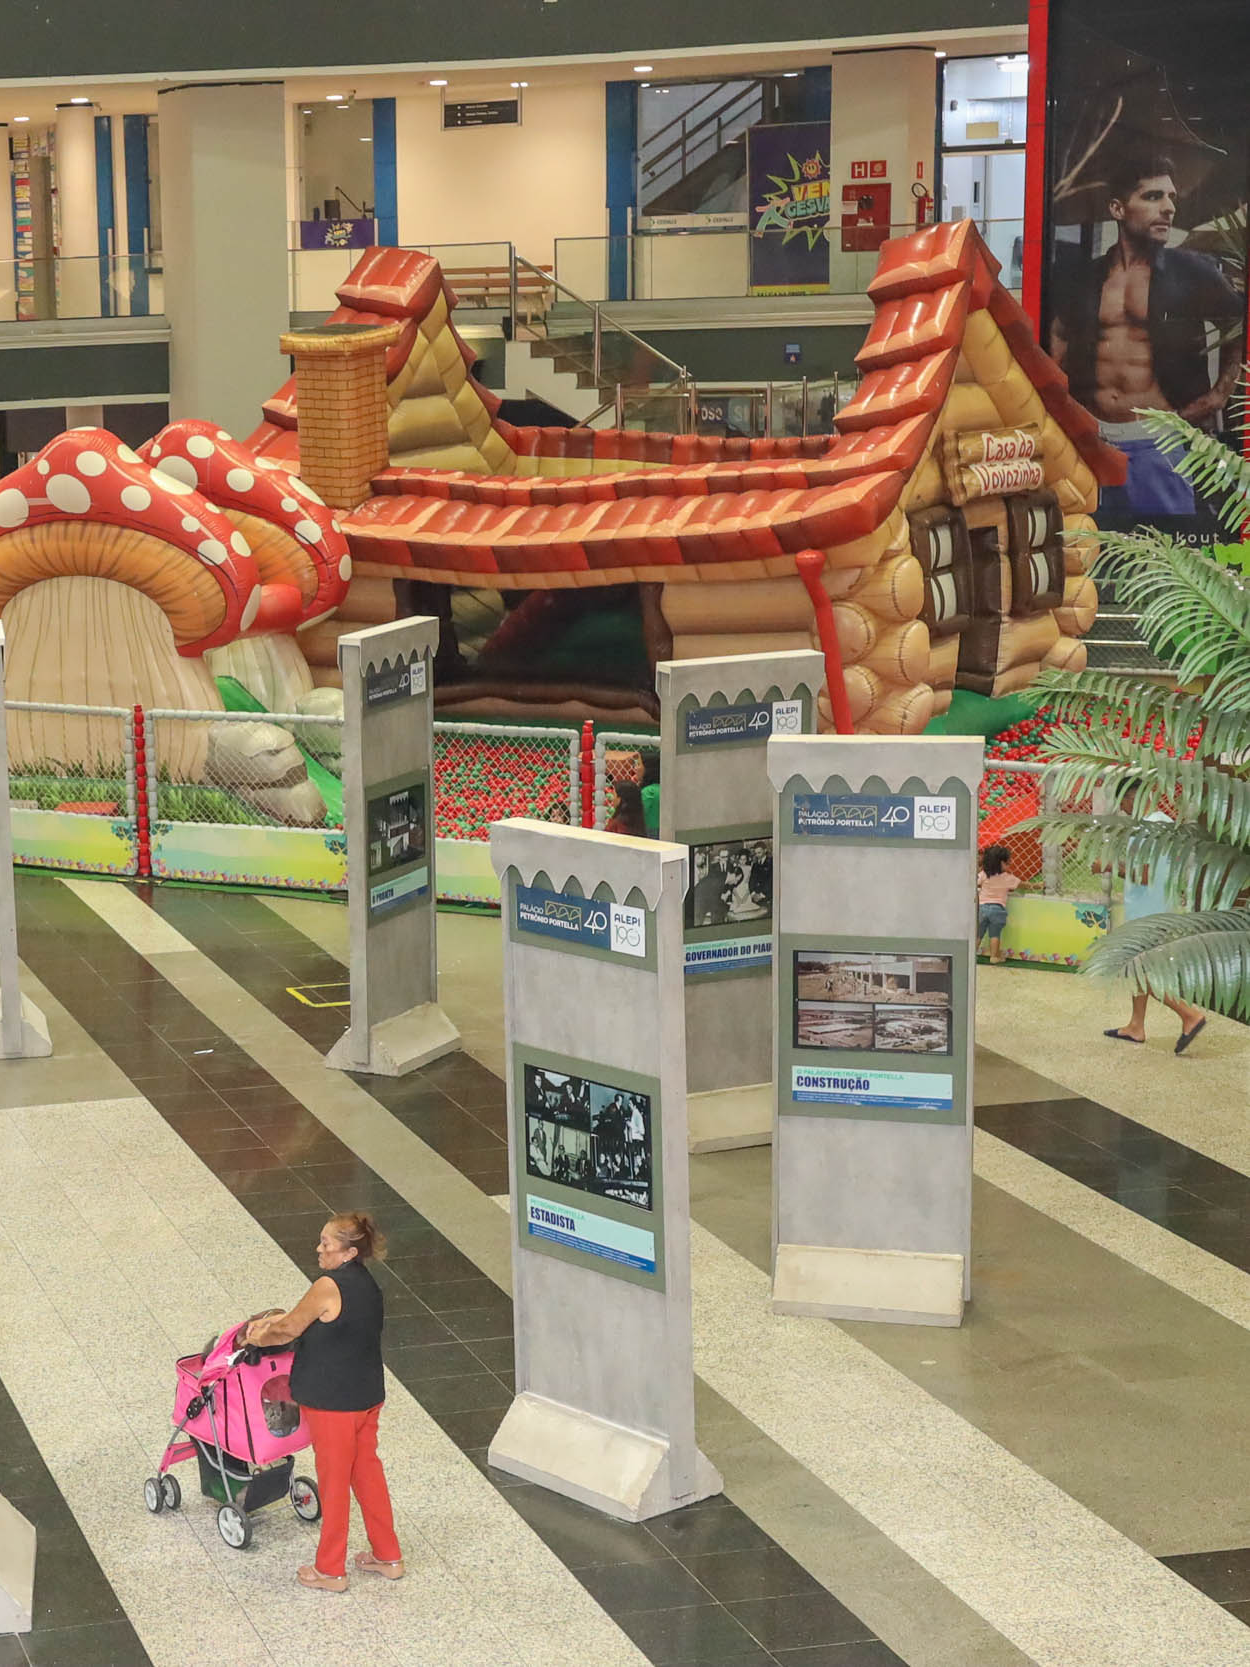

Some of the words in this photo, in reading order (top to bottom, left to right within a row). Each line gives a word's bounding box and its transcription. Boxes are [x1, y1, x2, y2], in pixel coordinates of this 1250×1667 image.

[986, 437, 1016, 462] Casa
[1018, 432, 1033, 458] da
[975, 461, 1041, 491] Vovozinha
[776, 707, 798, 715] ALEPI
[748, 711, 770, 731] 40
[716, 726, 744, 735] PORTELLA
[881, 806, 910, 828] 40
[918, 805, 951, 813] ALEPI
[798, 816, 835, 826] PETRÔNIO
[836, 819, 874, 828] PORTELLA
[520, 903, 544, 914] PALÁCIO
[520, 912, 549, 924] PETRÔNIO
[549, 918, 579, 931] PORTELLA
[584, 910, 607, 934] 40
[614, 913, 640, 927] ALEPI
[686, 946, 738, 961] GOVERNADOR
[740, 945, 751, 955] DO
[796, 1075, 870, 1092] CONSTRUÇÃO
[530, 1206, 575, 1232] ESTADISTA
